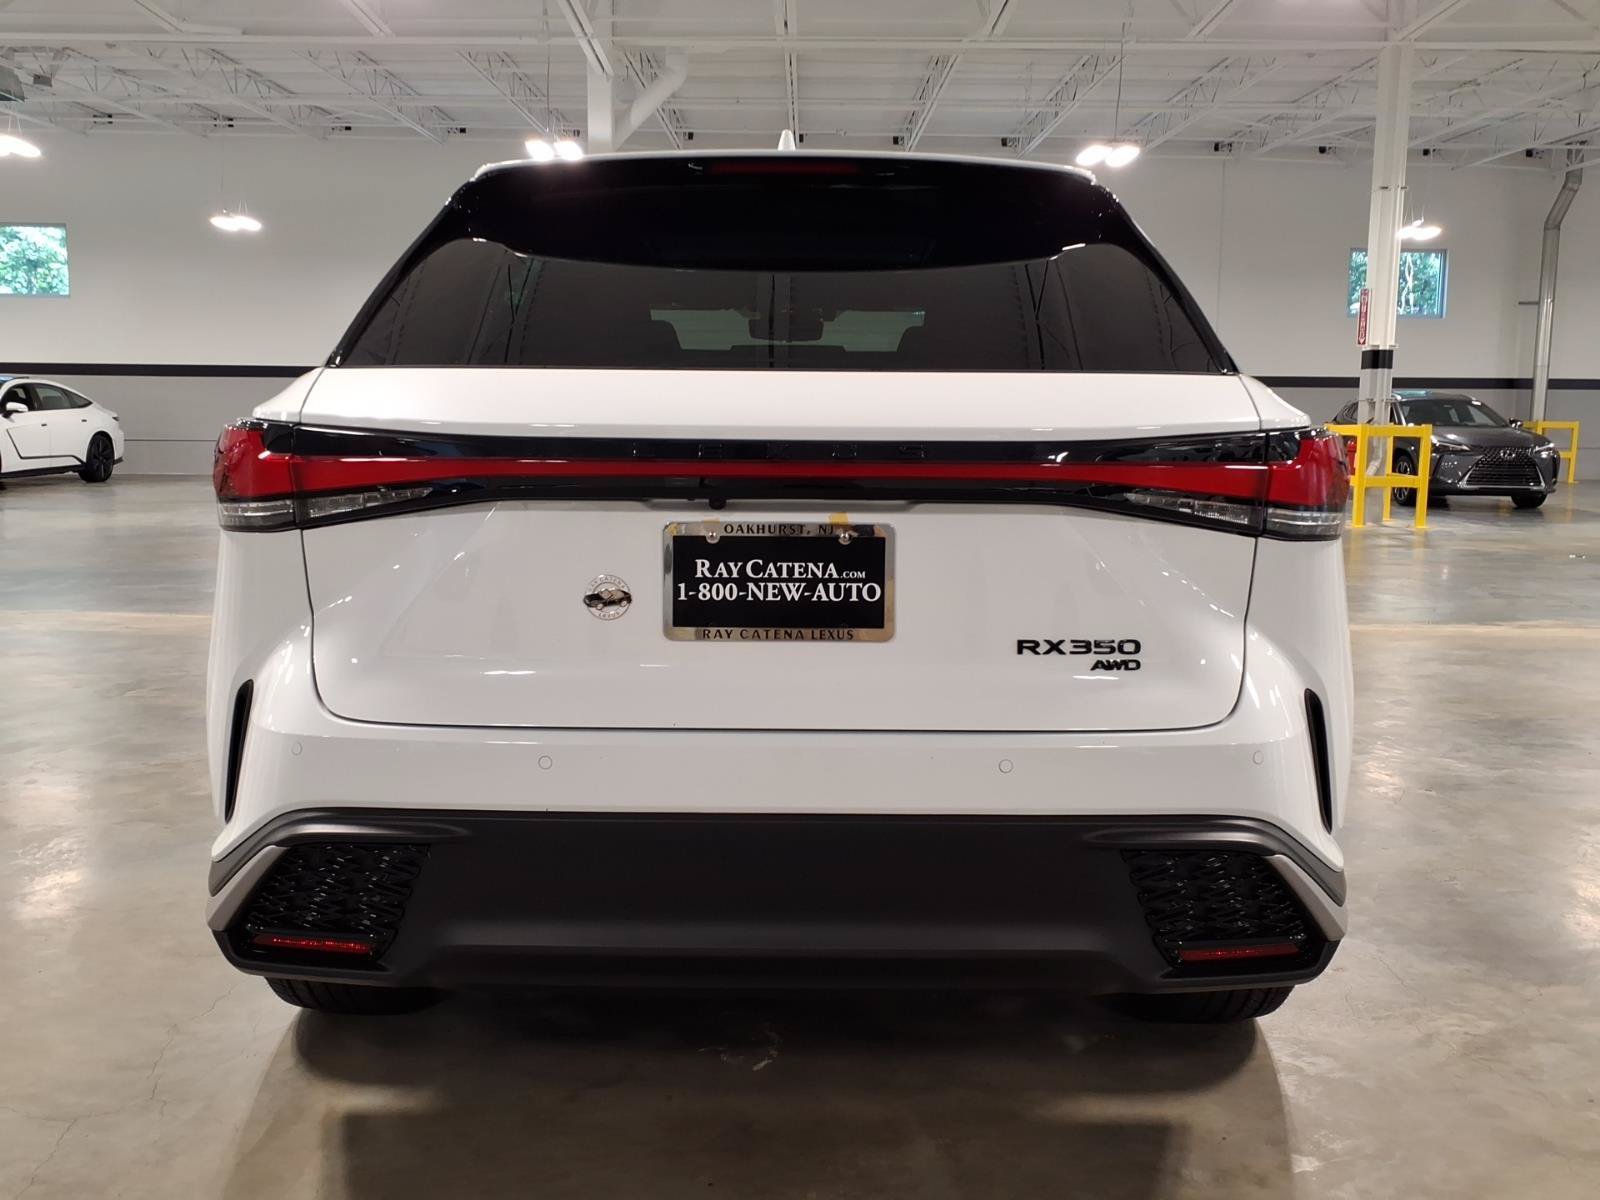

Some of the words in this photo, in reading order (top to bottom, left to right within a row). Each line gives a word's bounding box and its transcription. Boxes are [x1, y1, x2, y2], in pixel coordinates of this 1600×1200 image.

[818, 525, 834, 535] NJ
[695, 559, 742, 578] RAY
[677, 582, 882, 602] 1-800-NEW-AUTO
[703, 629, 733, 640] RAY
[740, 629, 804, 640] CATENA
[811, 629, 854, 640] LEXUS
[1090, 659, 1141, 671] AWD
